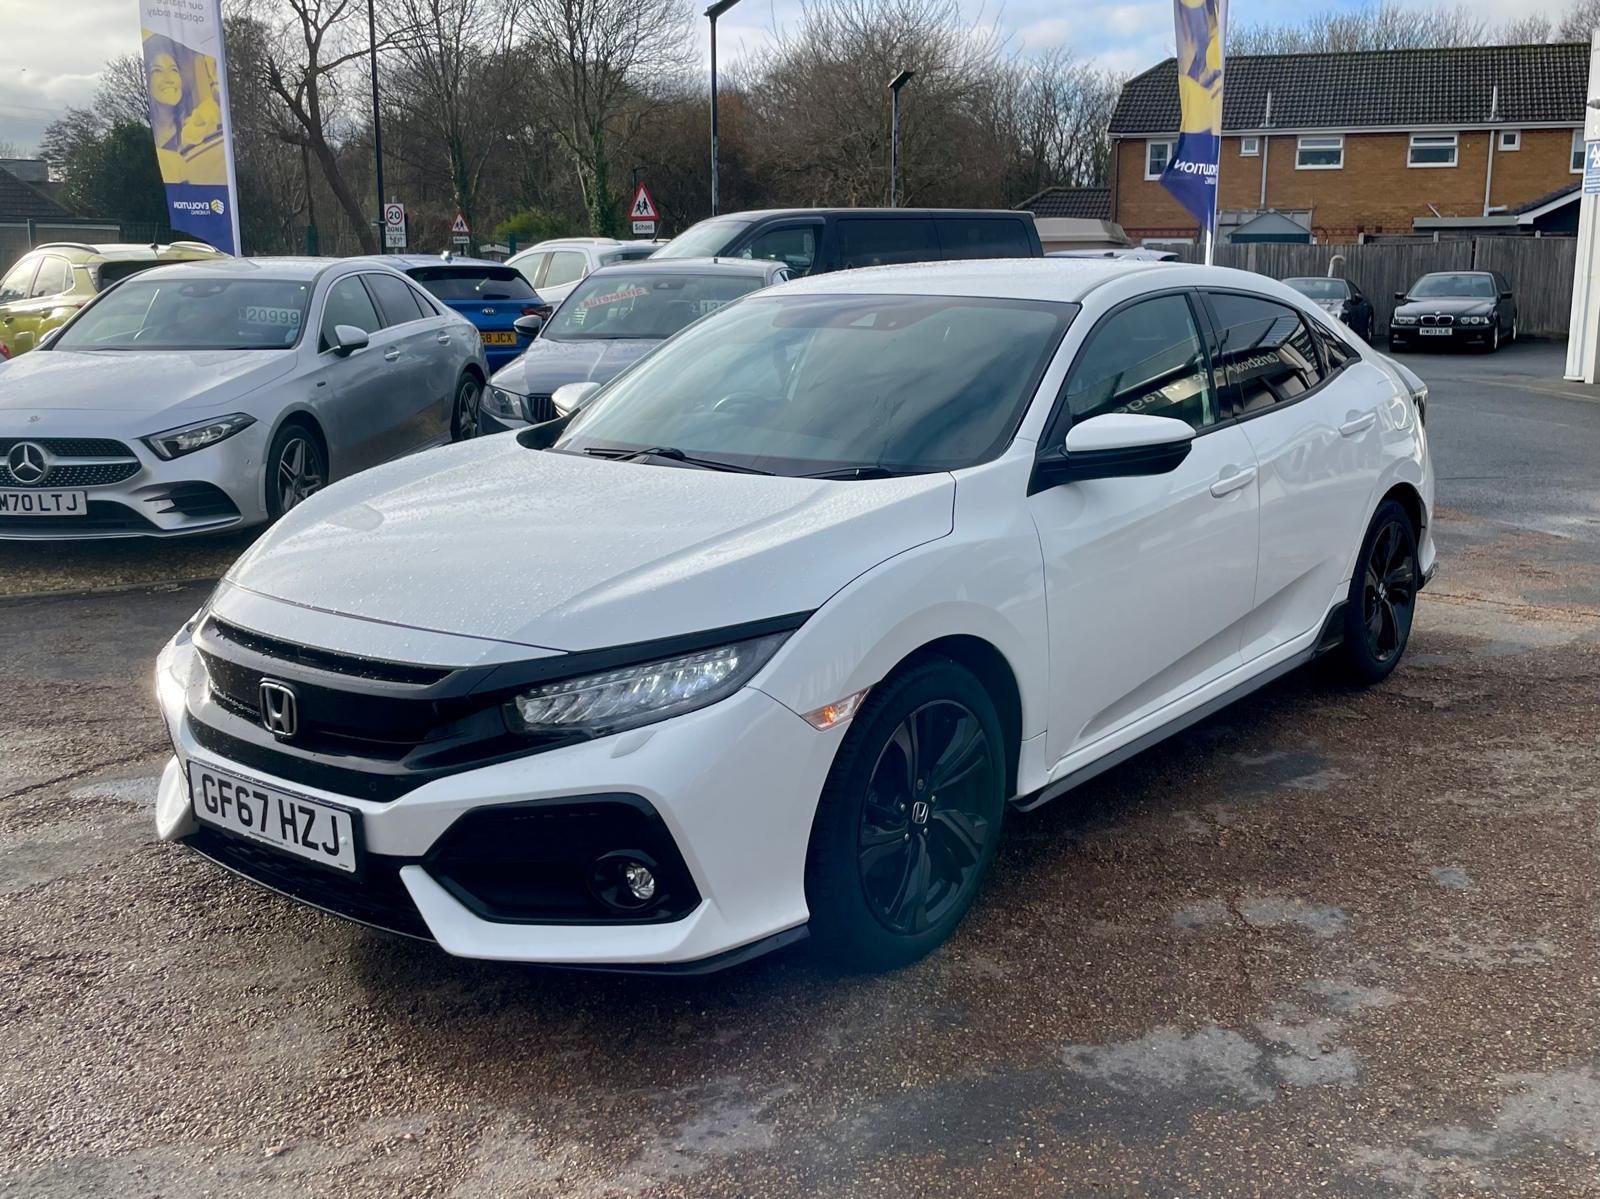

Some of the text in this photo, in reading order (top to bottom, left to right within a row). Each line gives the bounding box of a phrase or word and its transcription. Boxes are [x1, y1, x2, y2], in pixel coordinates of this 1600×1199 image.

[388, 210, 400, 220] 20
[634, 223, 653, 231] School
[583, 287, 644, 308] AUTOMATIC
[247, 307, 299, 325] 20999
[495, 333, 513, 343] JCX
[0, 494, 77, 511] M70 LTJ
[202, 773, 340, 857] GF67 HZJ
